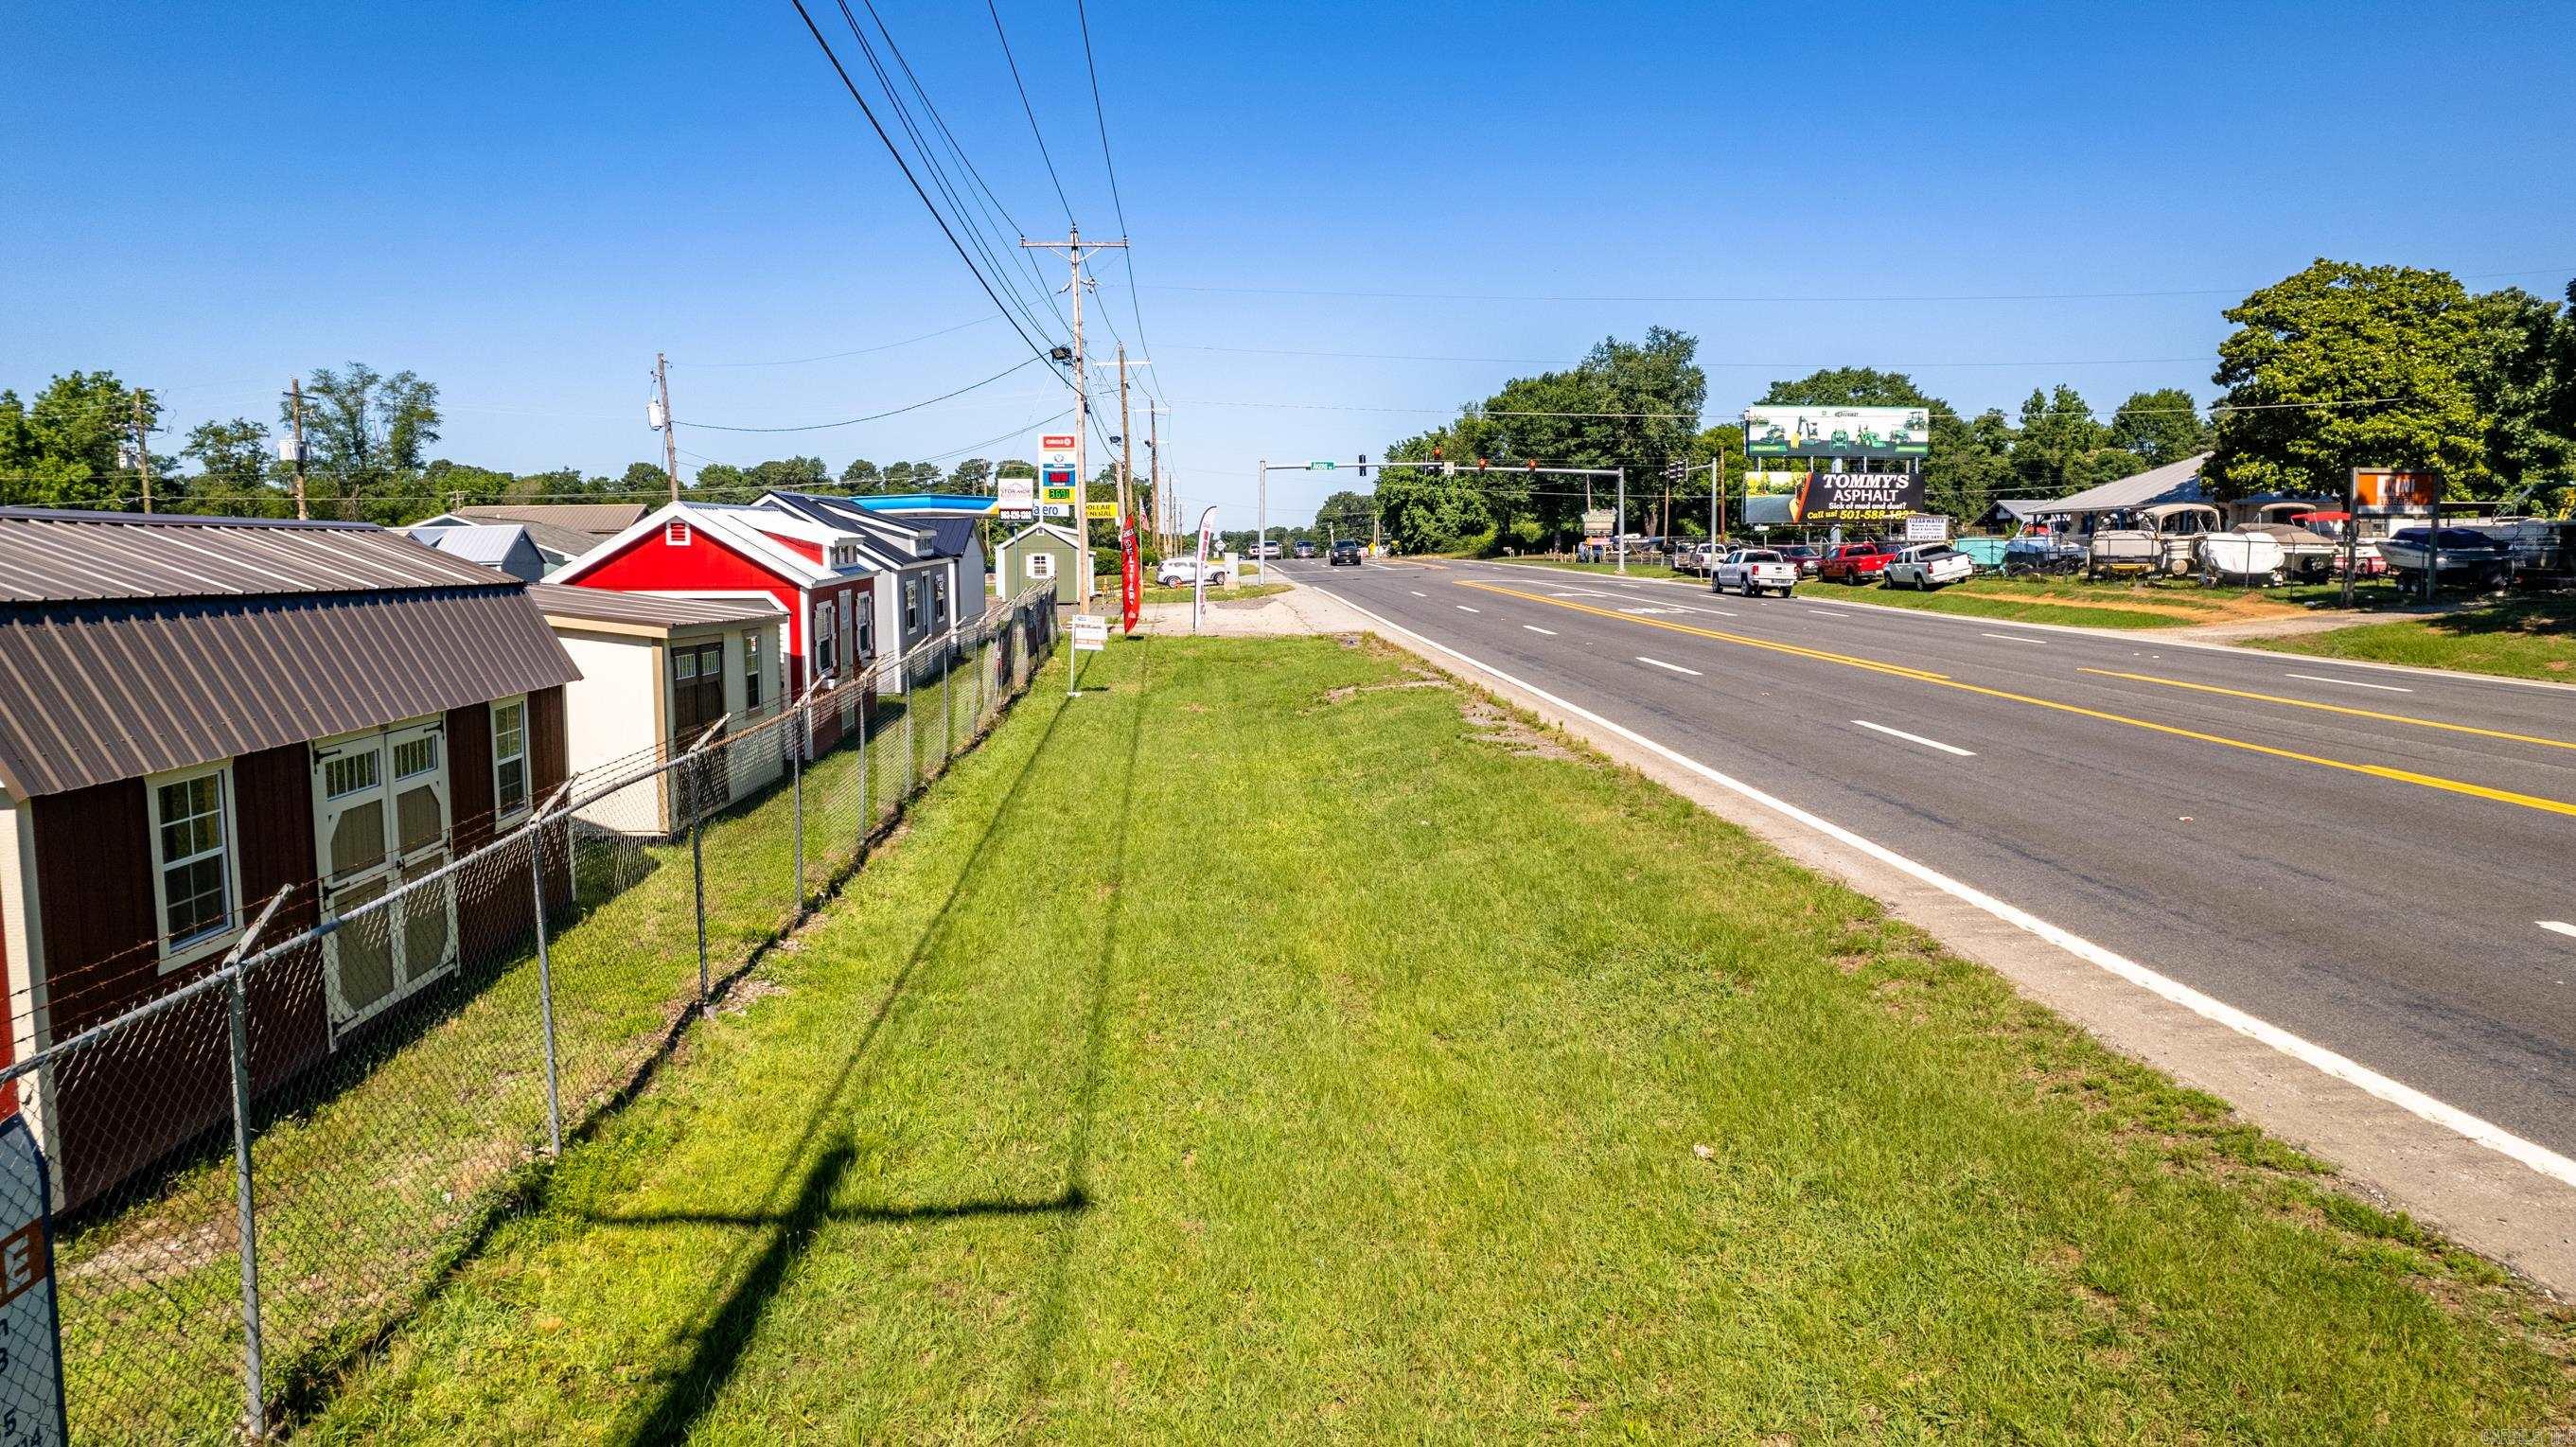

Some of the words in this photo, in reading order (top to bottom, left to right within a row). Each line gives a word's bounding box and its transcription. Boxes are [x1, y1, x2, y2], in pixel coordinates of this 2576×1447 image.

[1824, 474, 1910, 488] TOMMY'S
[1833, 489, 1899, 502] ASPHALT
[1808, 511, 1825, 520] Call
